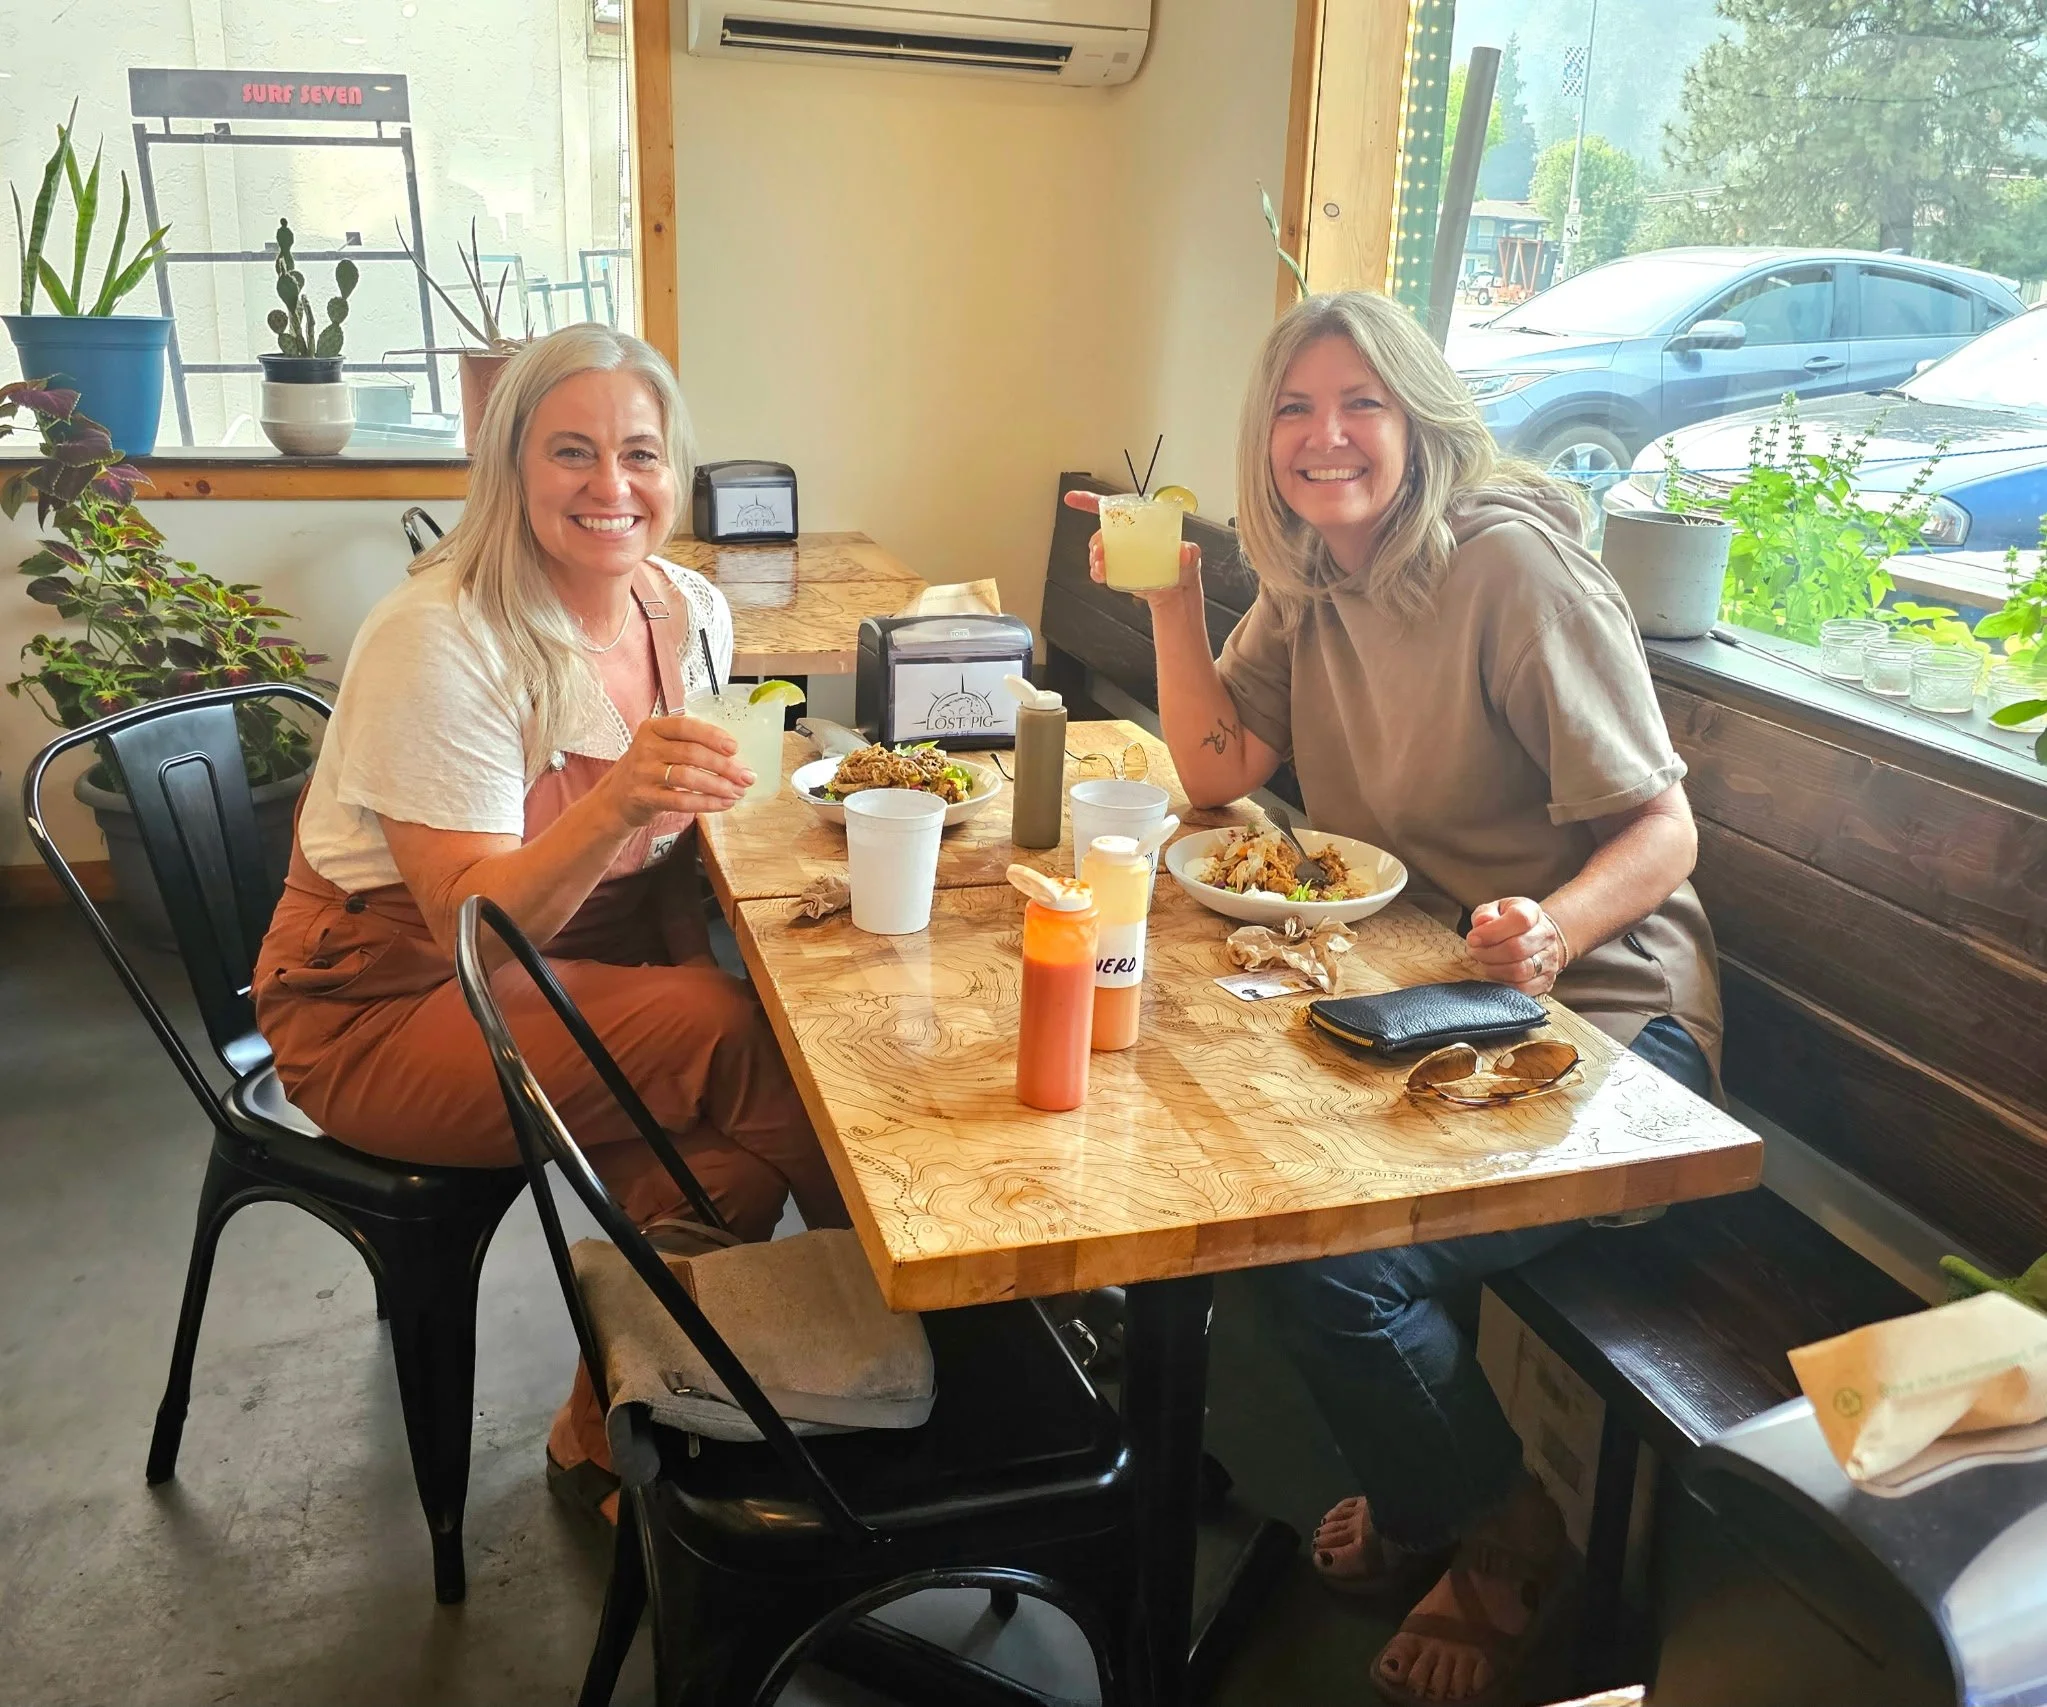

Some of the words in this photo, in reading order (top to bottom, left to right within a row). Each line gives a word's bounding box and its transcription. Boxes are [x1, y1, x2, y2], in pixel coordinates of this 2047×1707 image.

[242, 83, 295, 104] SURF
[300, 84, 363, 106] SEVEN
[926, 716, 965, 731] LOST
[970, 715, 993, 729] PIG
